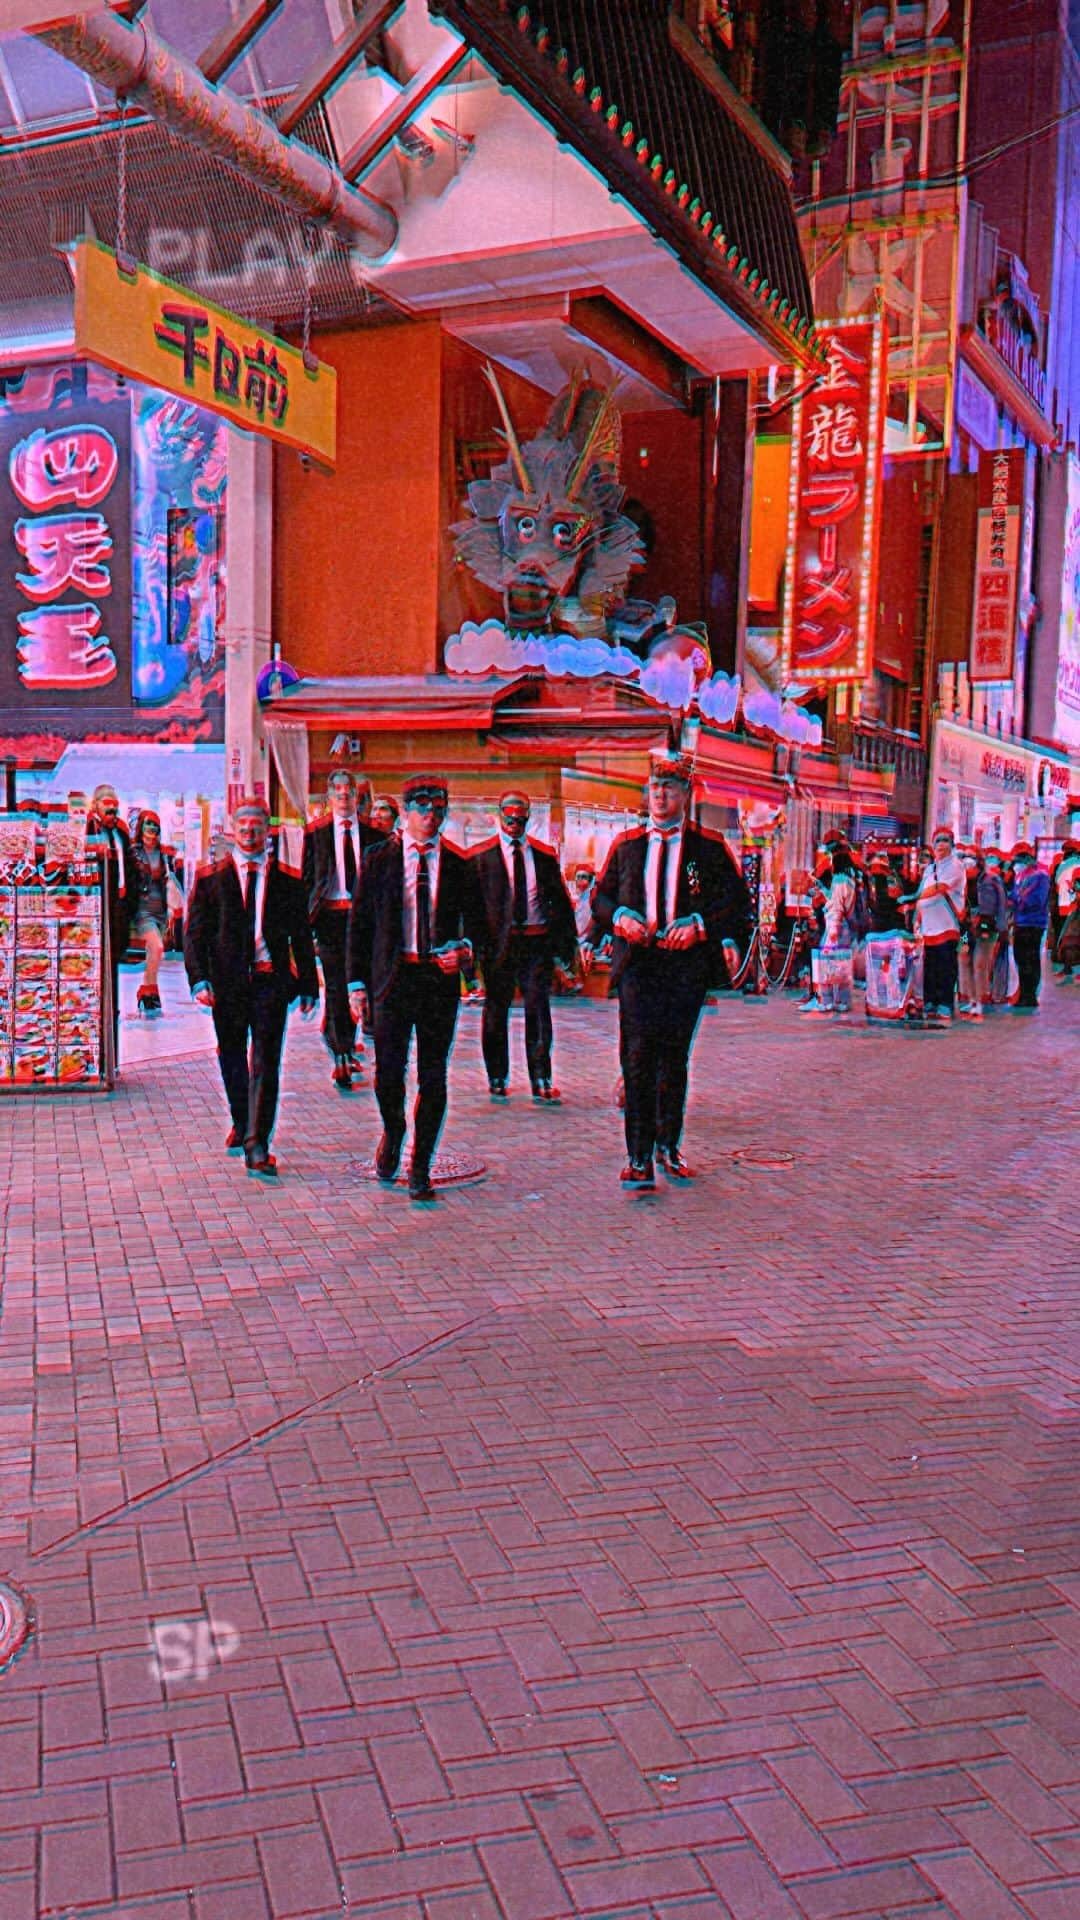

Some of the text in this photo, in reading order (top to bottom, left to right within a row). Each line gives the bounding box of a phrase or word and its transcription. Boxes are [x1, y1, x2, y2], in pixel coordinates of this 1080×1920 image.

[154, 302, 289, 425] 千日前
[798, 335, 867, 662] 金龍ラーメン
